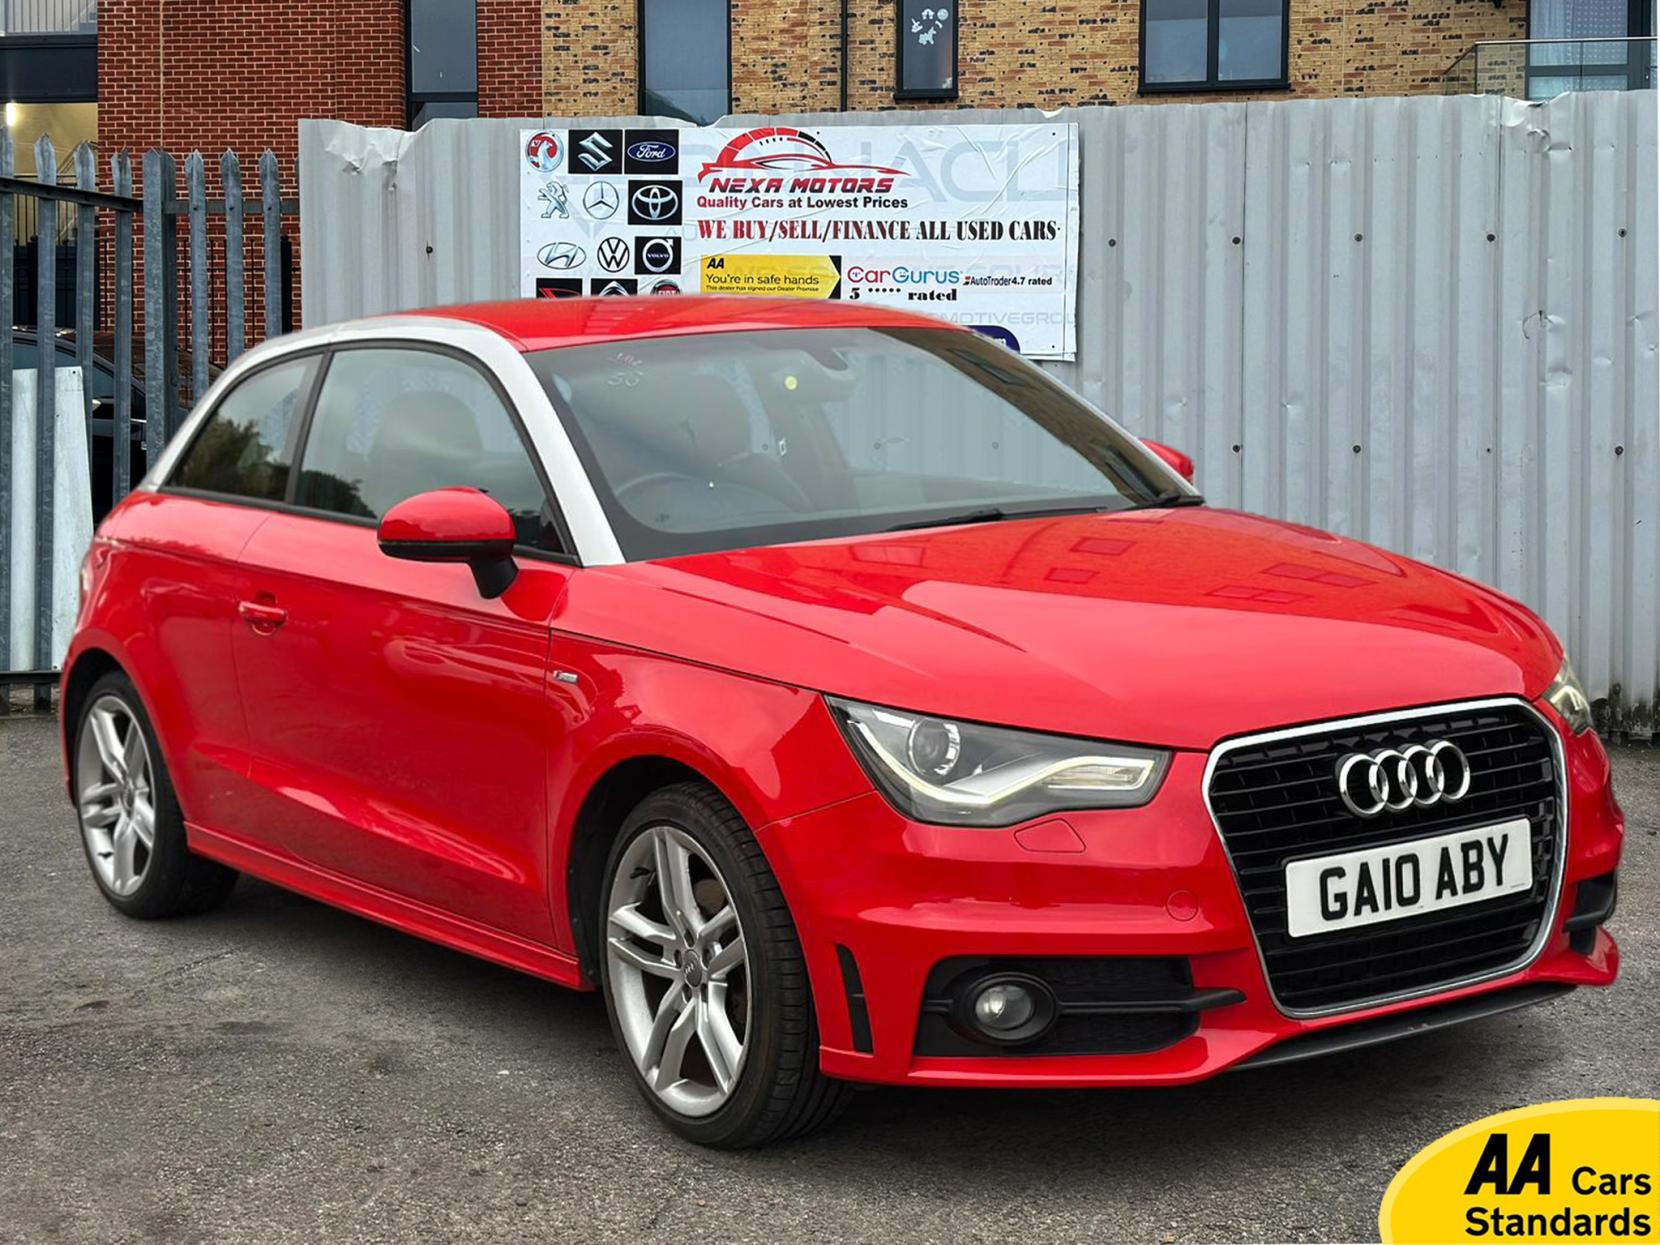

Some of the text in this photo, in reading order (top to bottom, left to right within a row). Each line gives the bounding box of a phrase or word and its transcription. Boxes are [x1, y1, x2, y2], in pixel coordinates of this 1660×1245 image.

[637, 144, 666, 158] Ford
[709, 178, 894, 193] NEXA MOTORS
[697, 196, 908, 210] Quality Cars at Lowest Prices
[697, 220, 727, 239] WE
[733, 220, 910, 243] BUY/SELL/FINANCE
[916, 221, 950, 240] ALL
[957, 221, 1004, 240] USED
[1009, 220, 1057, 240] CARS
[707, 258, 725, 269] AA
[706, 274, 819, 285] You're in safe hands
[847, 266, 960, 284] CarGurus
[1028, 277, 1052, 285] rated
[849, 287, 957, 301] 5 rated
[1319, 834, 1509, 921] GA10 ABY
